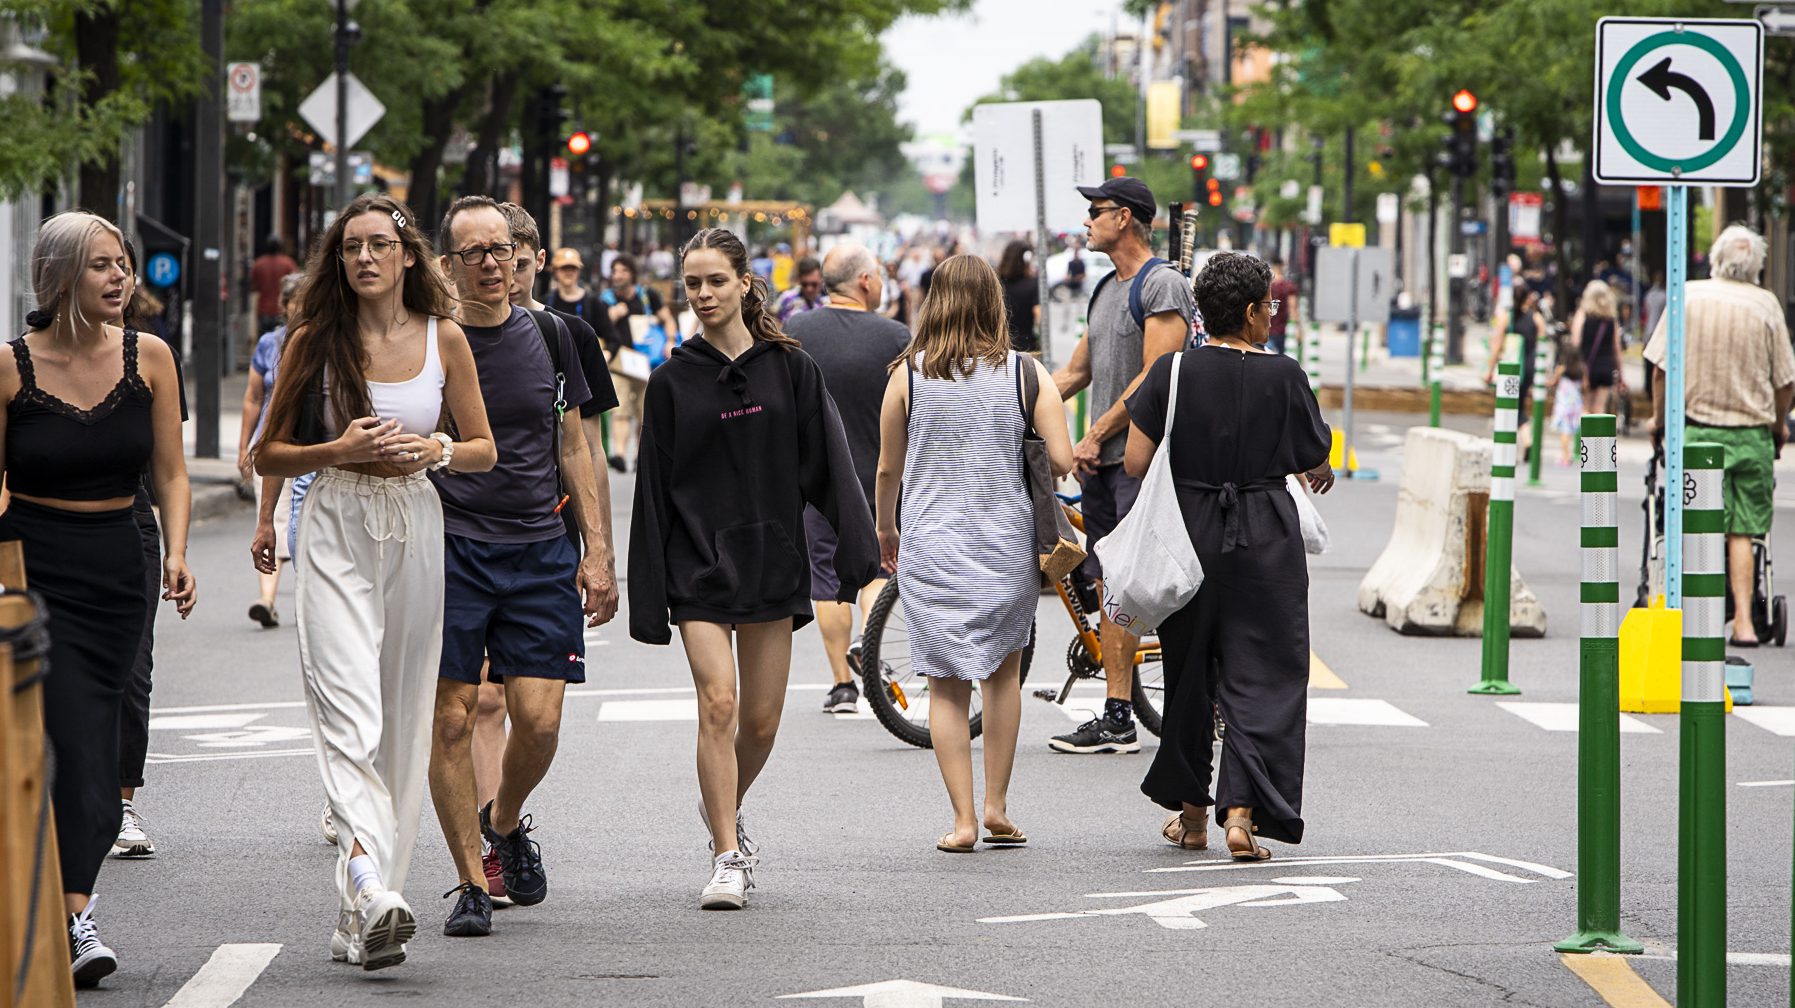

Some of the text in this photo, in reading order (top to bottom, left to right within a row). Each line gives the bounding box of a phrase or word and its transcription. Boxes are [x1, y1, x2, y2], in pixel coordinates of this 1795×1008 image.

[733, 409, 744, 417] NICE
[745, 405, 762, 415] HUMAN
[1061, 576, 1091, 632] HWINN
